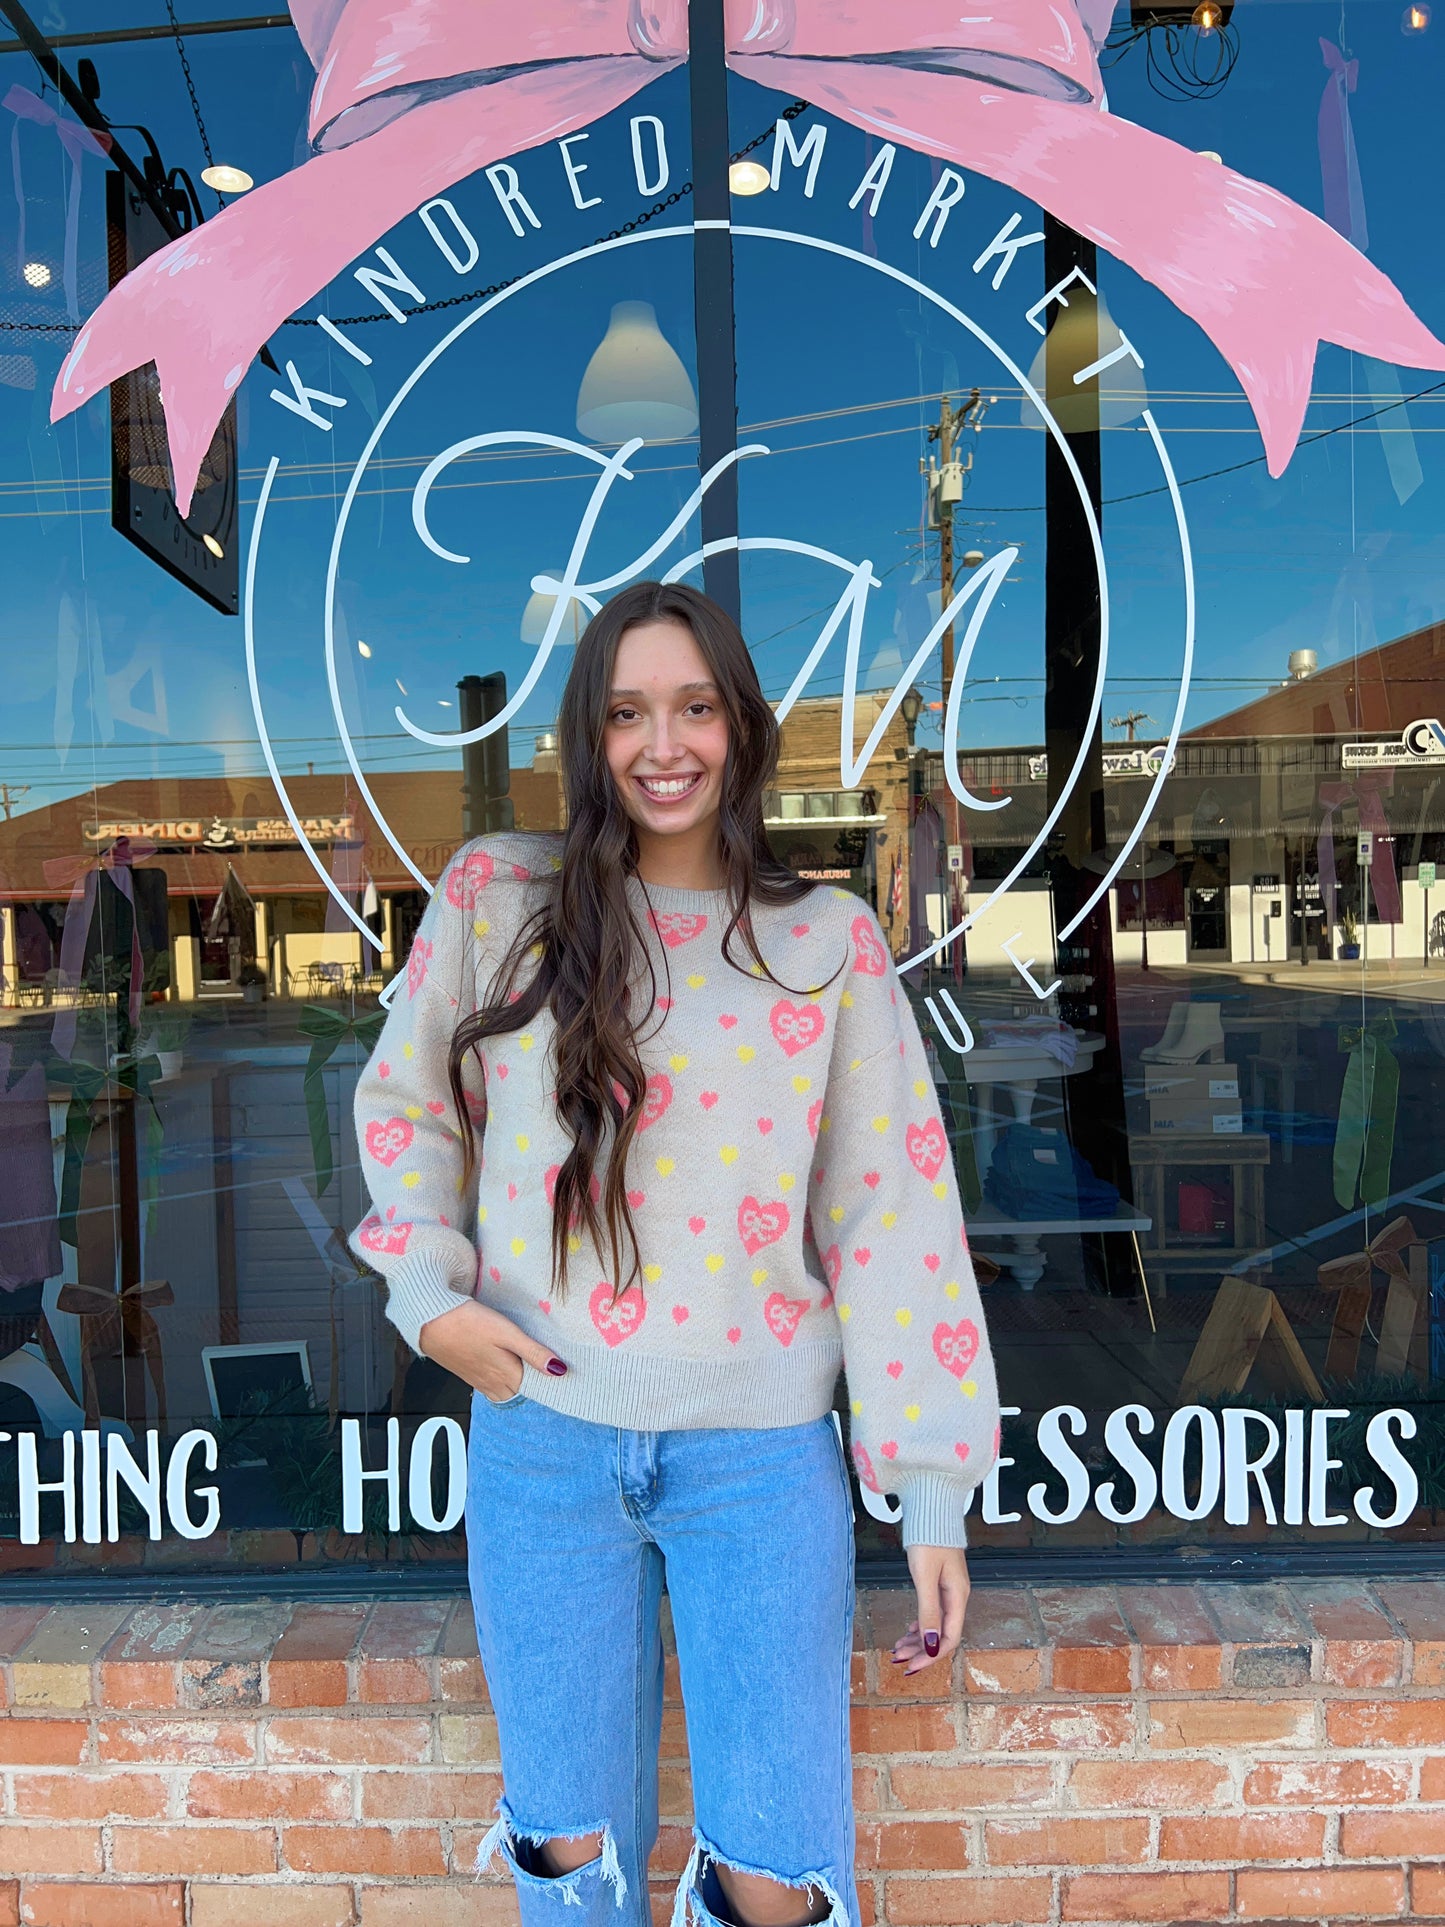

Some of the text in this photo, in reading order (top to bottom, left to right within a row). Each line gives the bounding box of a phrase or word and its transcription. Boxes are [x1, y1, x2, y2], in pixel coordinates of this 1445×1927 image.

[270, 115, 1144, 431] KINDRED MARKET
[0, 1404, 1418, 1544] HING HO ESSORIES
